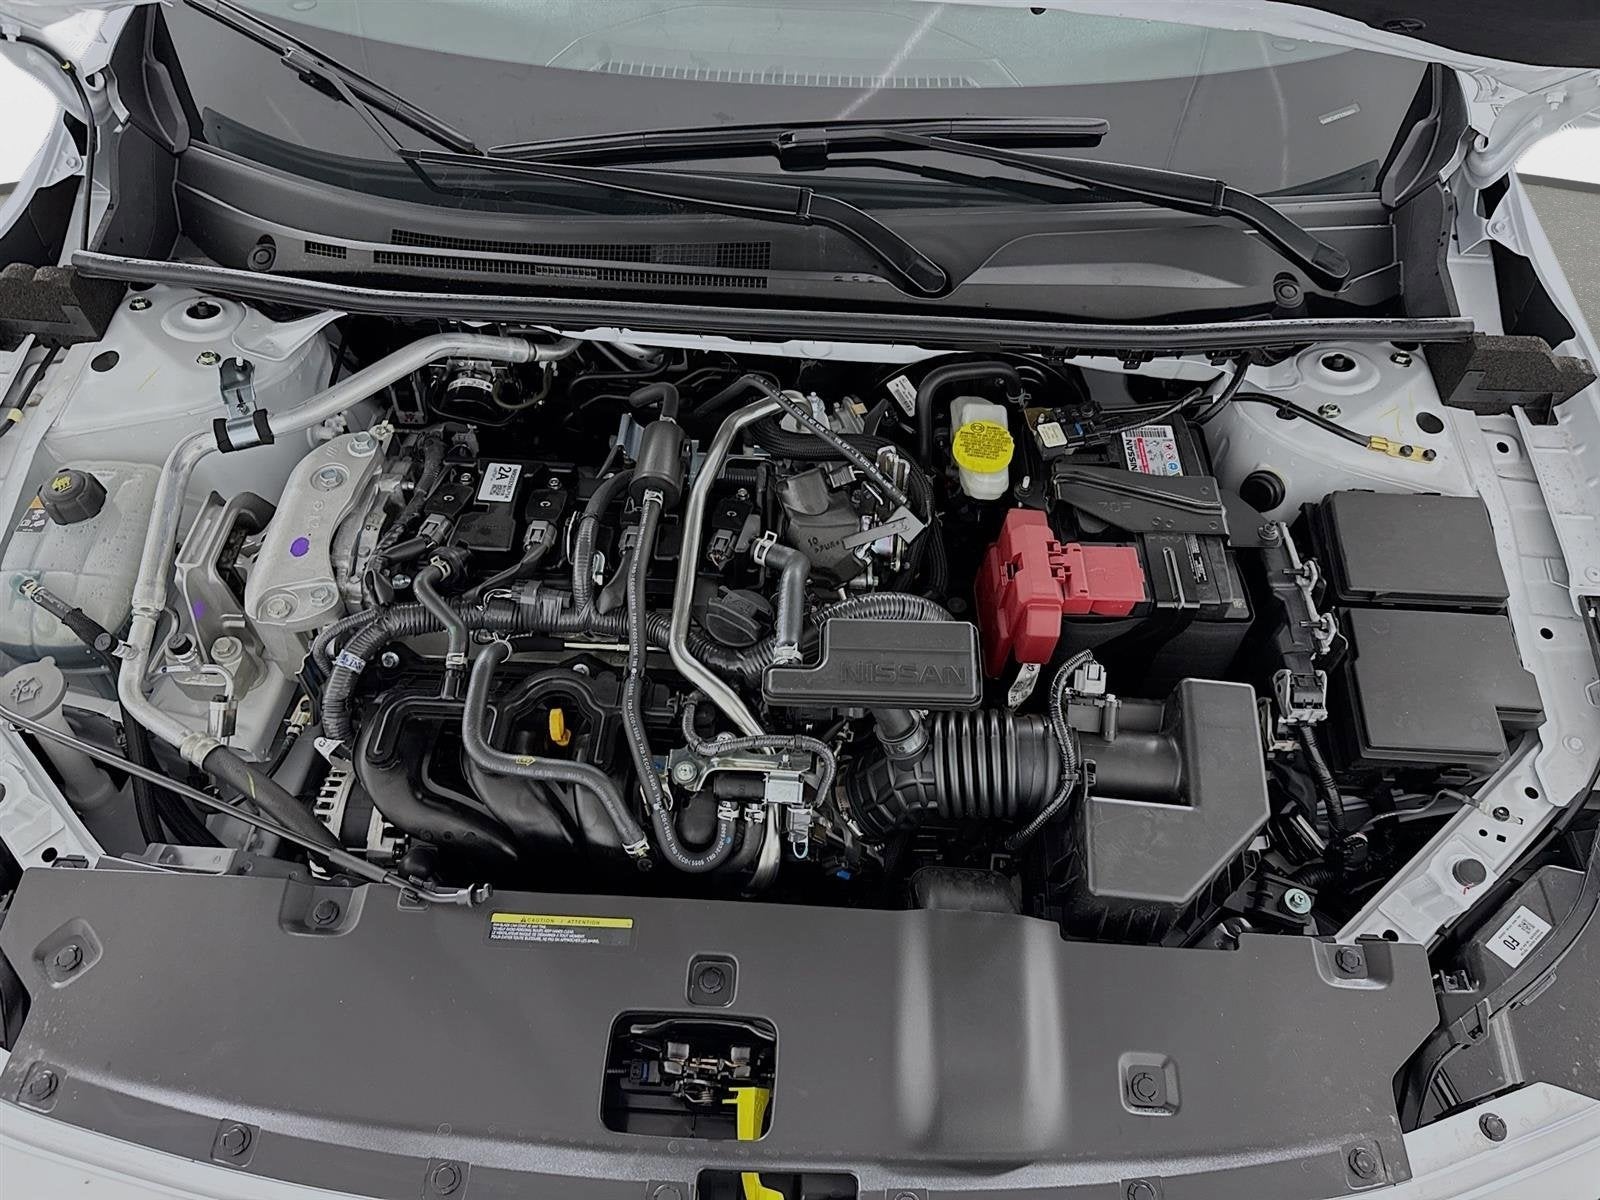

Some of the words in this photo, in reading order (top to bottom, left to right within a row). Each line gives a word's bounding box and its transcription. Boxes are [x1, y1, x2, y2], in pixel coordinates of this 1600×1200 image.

[1124, 438, 1139, 471] NISSAN
[495, 466, 512, 481] 2A
[840, 660, 967, 685] NISSAN
